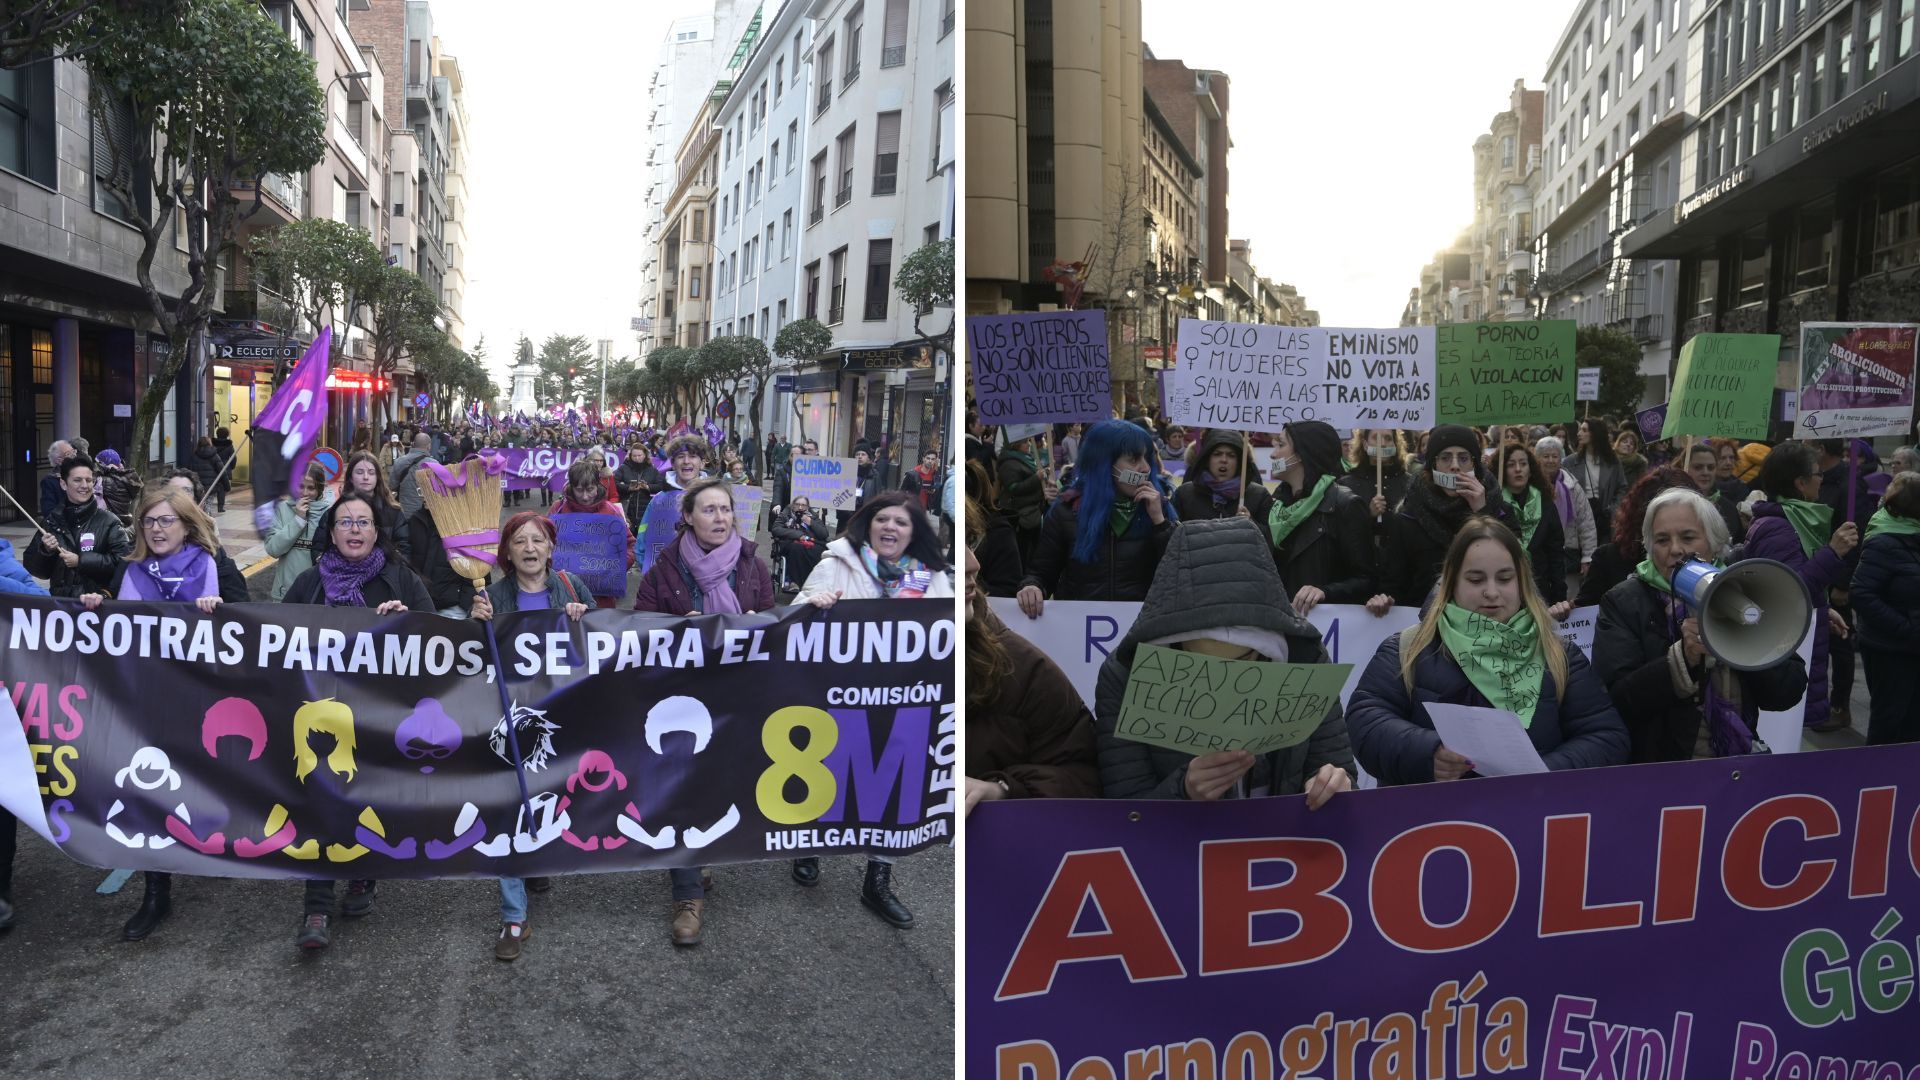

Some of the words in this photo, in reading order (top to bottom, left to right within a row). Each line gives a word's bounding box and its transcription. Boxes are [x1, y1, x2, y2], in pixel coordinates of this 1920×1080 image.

[973, 323, 1007, 350] LOS
[1012, 318, 1090, 347] PUTEROS
[1200, 322, 1258, 349] SÓLO
[1277, 331, 1310, 350] LAS
[1438, 326, 1464, 344] EL
[1476, 325, 1540, 344] PORNO
[1704, 337, 1736, 355] DICE
[864, 358, 898, 368] GOLD
[977, 350, 1003, 374] NO
[1006, 347, 1044, 371] SON
[1046, 344, 1109, 370] CLIENTES
[1209, 350, 1309, 377] MUJERES
[1326, 359, 1352, 380] NO
[1361, 359, 1404, 379] VOTA
[1411, 360, 1420, 377] A
[1438, 349, 1461, 364] ES
[1471, 348, 1491, 363] LA
[1811, 356, 1831, 384] LEY
[1829, 342, 1906, 389] ABOLICIONISTA
[979, 373, 1021, 394] SON
[1028, 371, 1110, 394] VIOLADORES
[1193, 376, 1260, 400] SALVAN
[1270, 382, 1283, 400] A
[1288, 384, 1320, 403] LAS
[1439, 372, 1460, 388] LA
[1470, 364, 1563, 385] VIOLACIÓN
[1829, 384, 1855, 393] SISTEMA
[1855, 385, 1903, 395] PROSTITUCIONAL
[980, 398, 1013, 417] CON
[1022, 394, 1099, 415] BILLETES
[1198, 402, 1294, 425] MUJERES
[1440, 396, 1467, 416] ES
[1475, 394, 1493, 413] LA
[1502, 390, 1571, 413] PRÁCTICA
[794, 458, 842, 475] CUANDO
[1571, 619, 1591, 629] VOTA
[9, 607, 245, 666] NOSOTRAS
[258, 623, 497, 684] PARAMOS,
[514, 632, 572, 677] SE
[587, 627, 705, 675] PARA
[719, 629, 770, 665] EL
[785, 618, 955, 664] MUNDO
[1132, 650, 1263, 695] ABAJO
[1276, 666, 1317, 698] EL
[827, 680, 942, 706] COMISIÓN
[1130, 679, 1217, 721] TECHO
[1223, 694, 1331, 726] ARRIBA
[1117, 706, 1167, 739] LOS
[1174, 724, 1301, 751] DERECHOS
[756, 705, 932, 825] 8M
[925, 702, 955, 818] LEÓN
[765, 827, 857, 851] HUELGA
[858, 818, 948, 849] FEMINISTA
[994, 785, 1920, 1001] ABOLICI
[1781, 907, 1920, 1028] Gé
